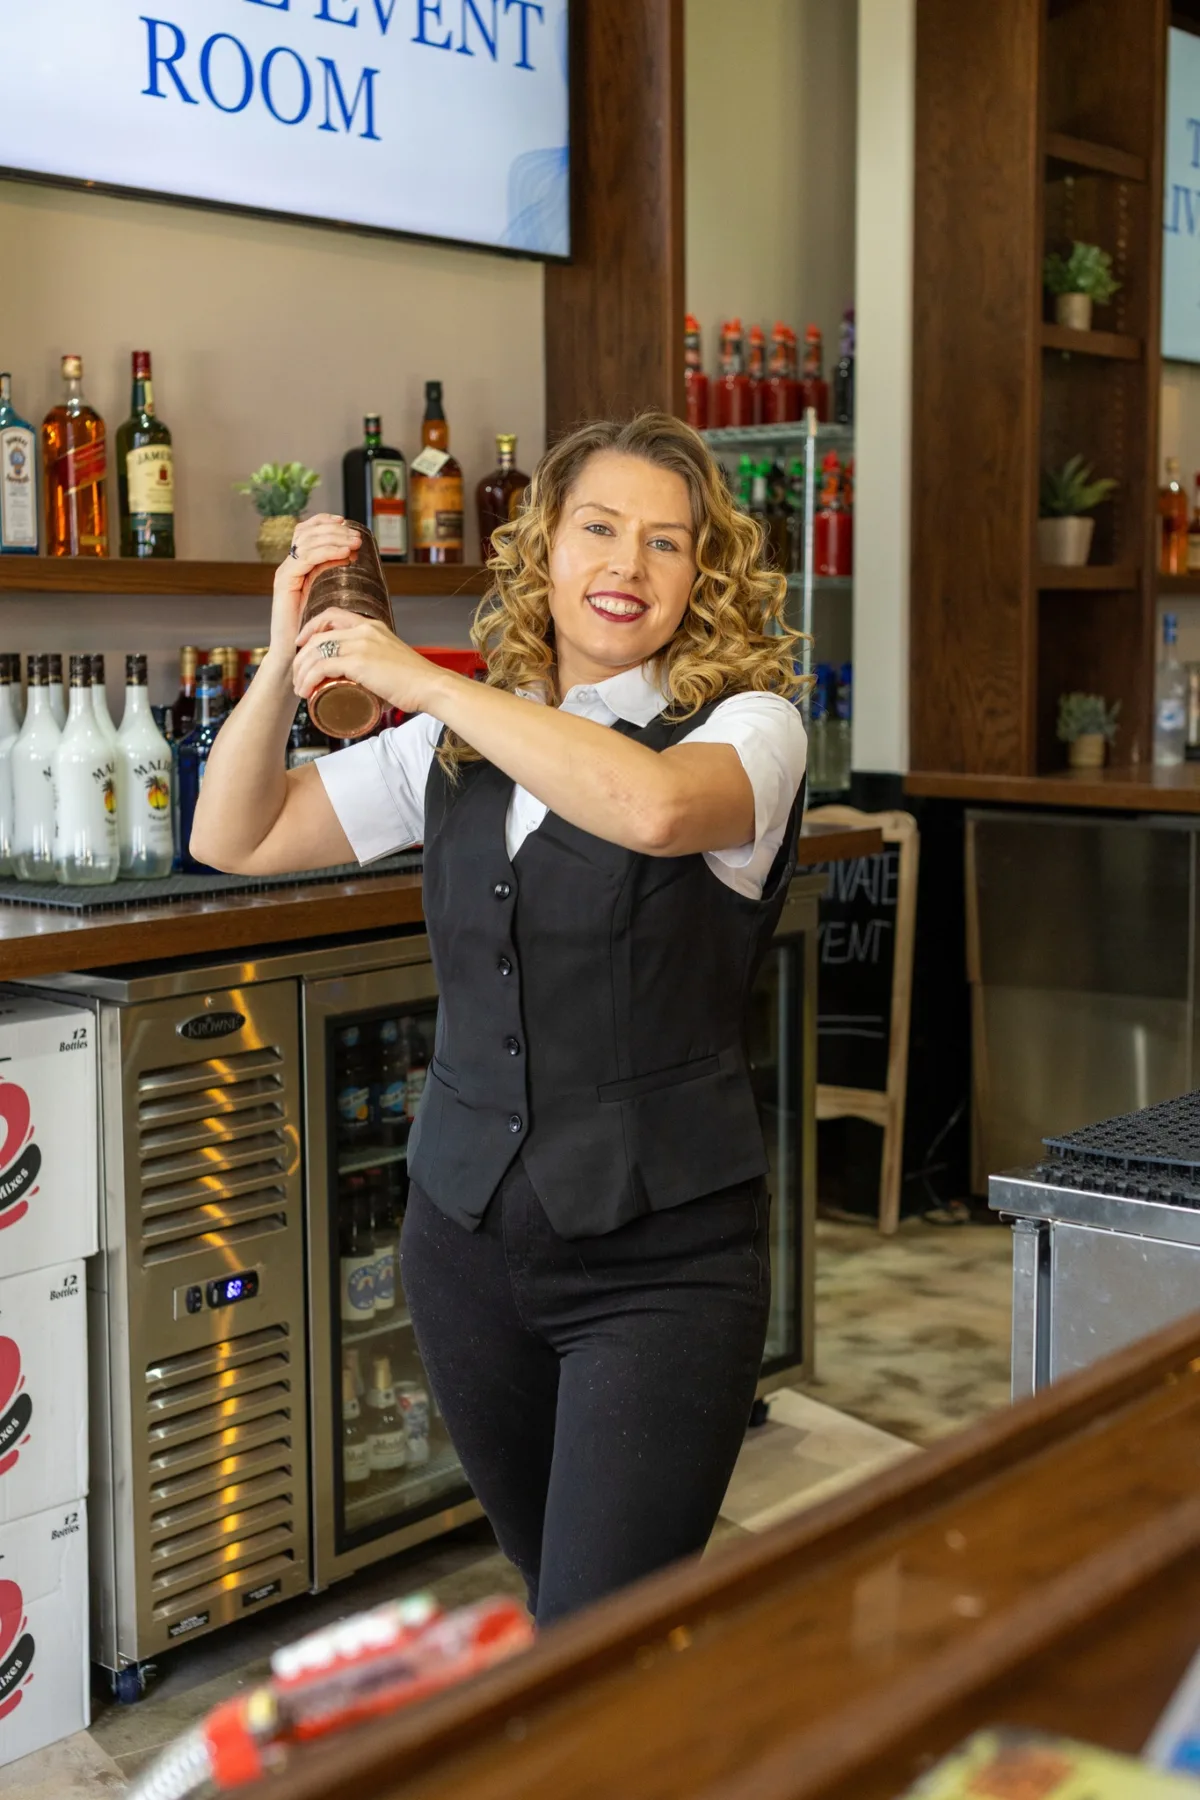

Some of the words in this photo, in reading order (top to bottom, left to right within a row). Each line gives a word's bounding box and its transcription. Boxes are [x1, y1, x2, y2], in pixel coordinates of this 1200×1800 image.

[139, 16, 382, 141] ROOM
[818, 919, 892, 964] ENT
[72, 1027, 87, 1040] 12
[59, 1040, 88, 1052] Bottles
[63, 1274, 78, 1287] 12
[50, 1286, 79, 1300] Bottles
[64, 1512, 78, 1525] 12
[51, 1524, 80, 1541] Bottles
